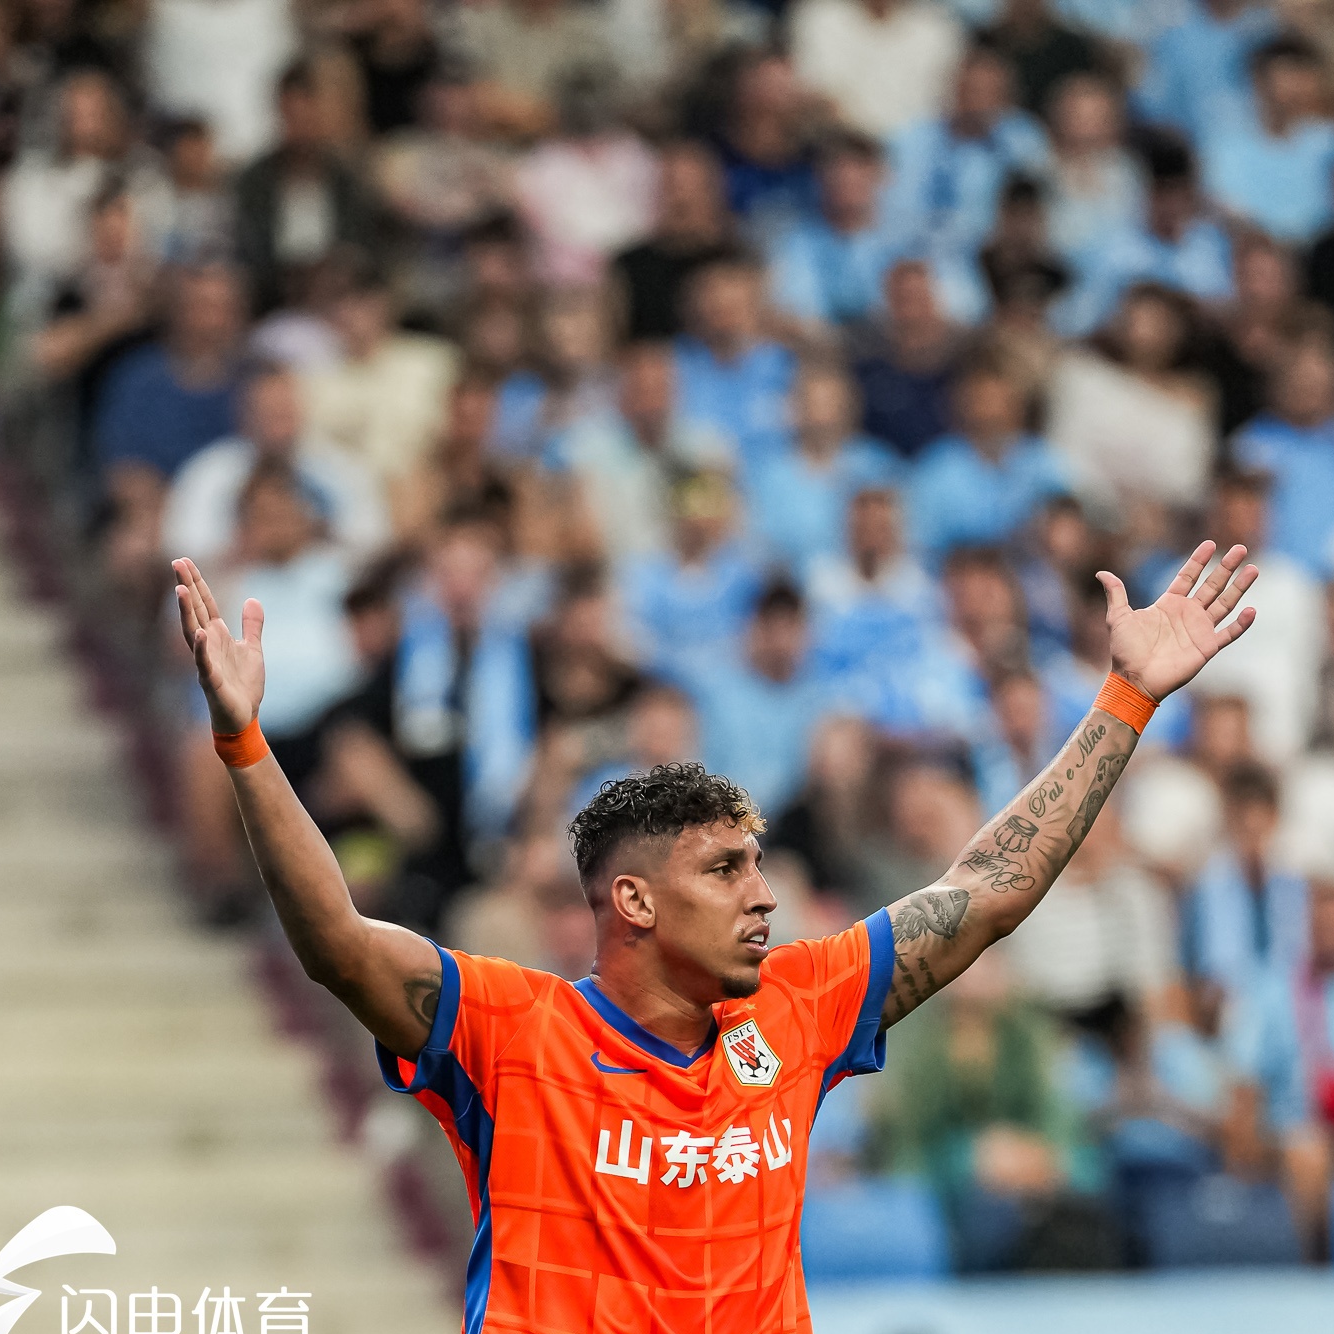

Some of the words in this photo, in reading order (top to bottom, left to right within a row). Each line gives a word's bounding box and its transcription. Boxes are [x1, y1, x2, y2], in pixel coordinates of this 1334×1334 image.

[725, 1024, 754, 1043] TSFC
[595, 1112, 792, 1189] 山东泰山
